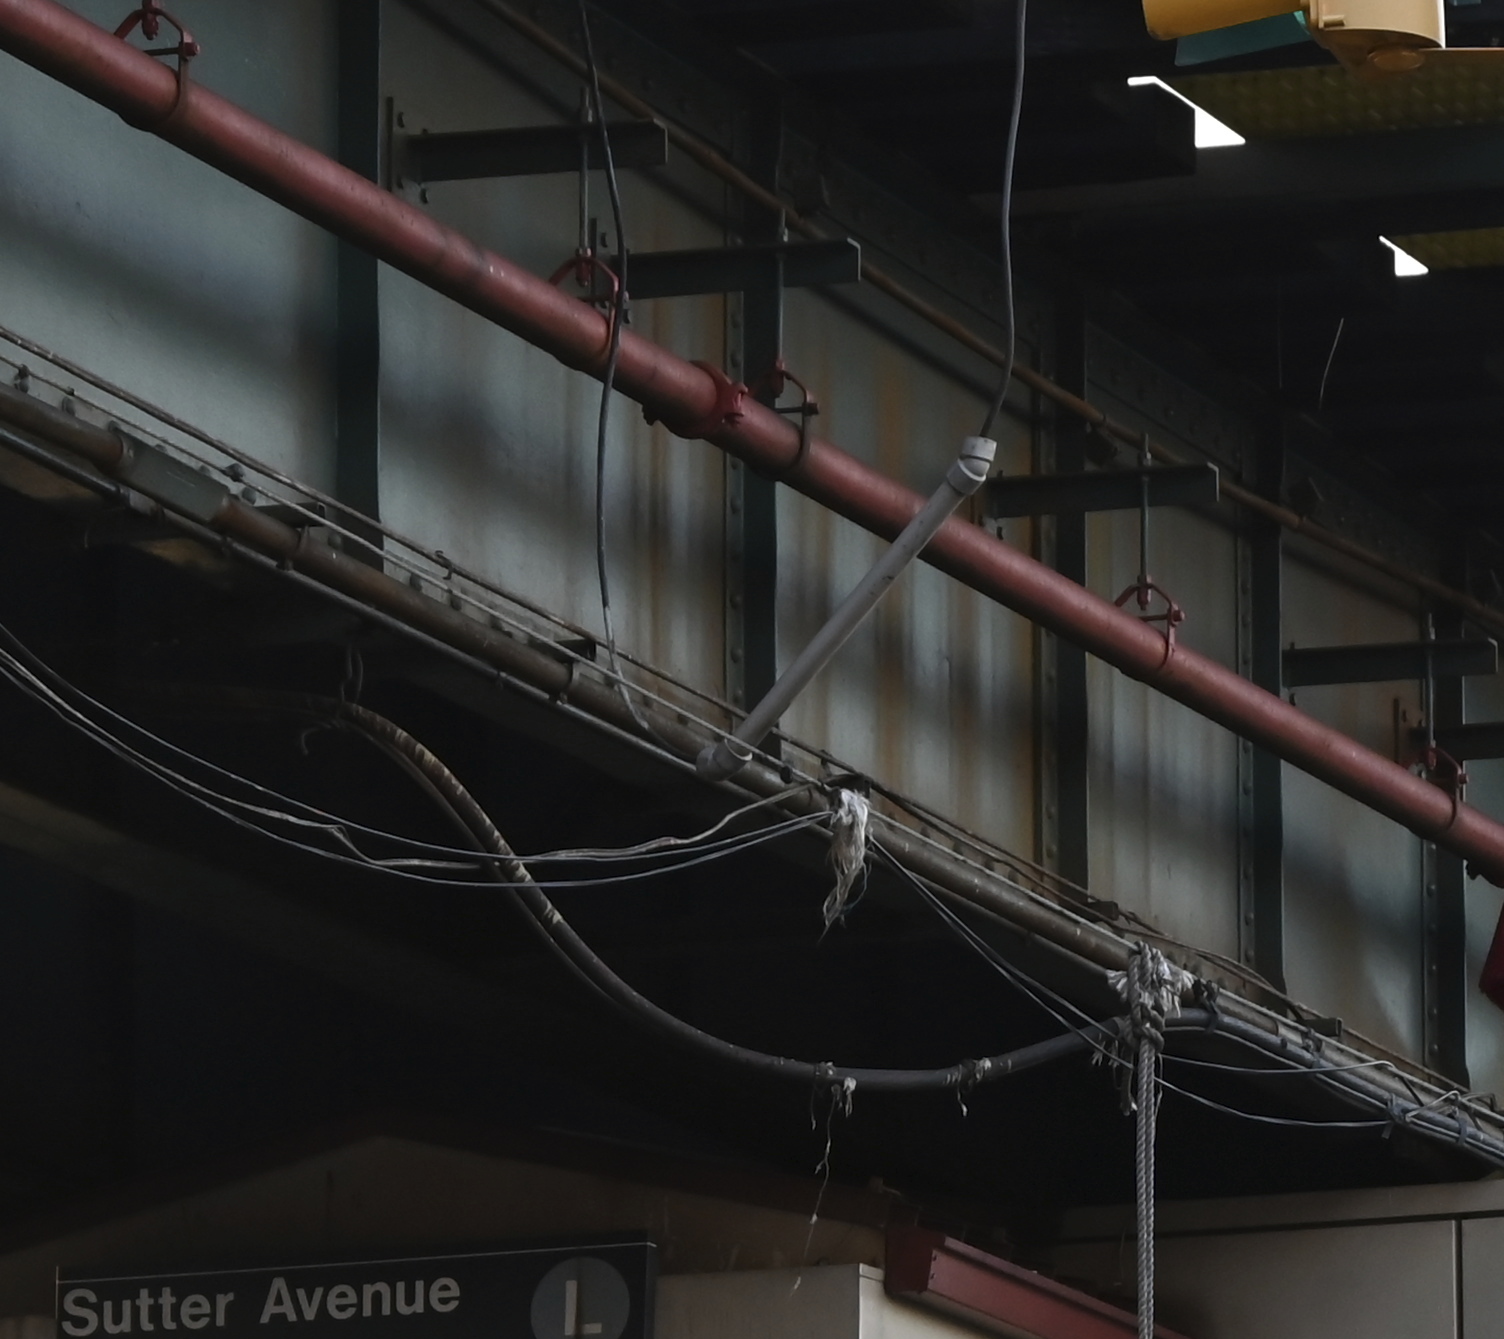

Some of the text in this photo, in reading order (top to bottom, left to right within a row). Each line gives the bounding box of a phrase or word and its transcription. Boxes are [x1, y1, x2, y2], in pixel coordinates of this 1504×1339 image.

[61, 1276, 461, 1337] Sutter Avenue
[565, 1280, 602, 1335] L
